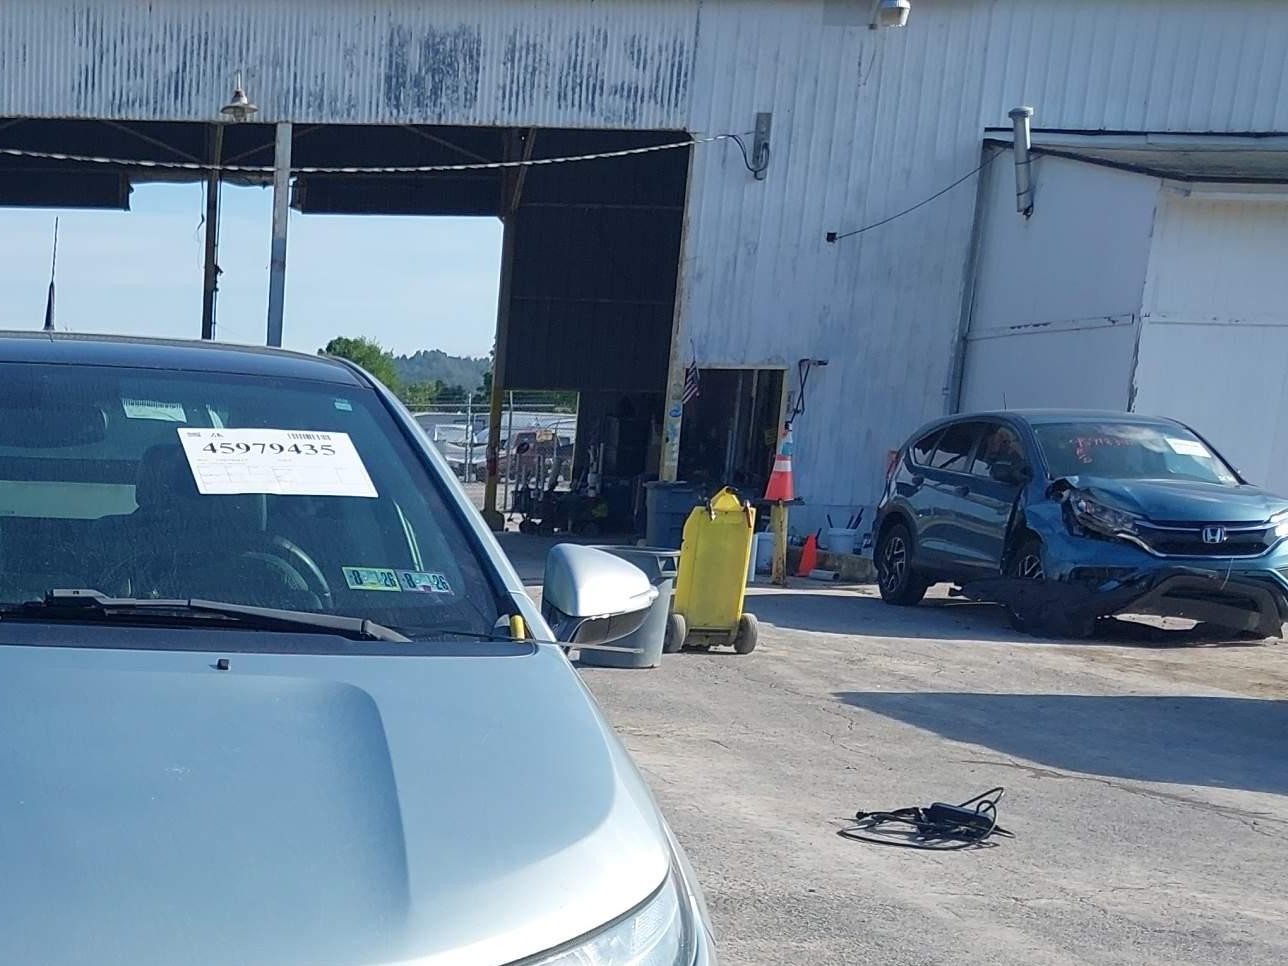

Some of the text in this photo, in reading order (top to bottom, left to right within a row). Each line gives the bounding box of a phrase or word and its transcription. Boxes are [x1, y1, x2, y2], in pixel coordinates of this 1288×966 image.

[202, 442, 337, 456] 45979435
[381, 572, 397, 588] 26
[432, 575, 449, 590] 26
